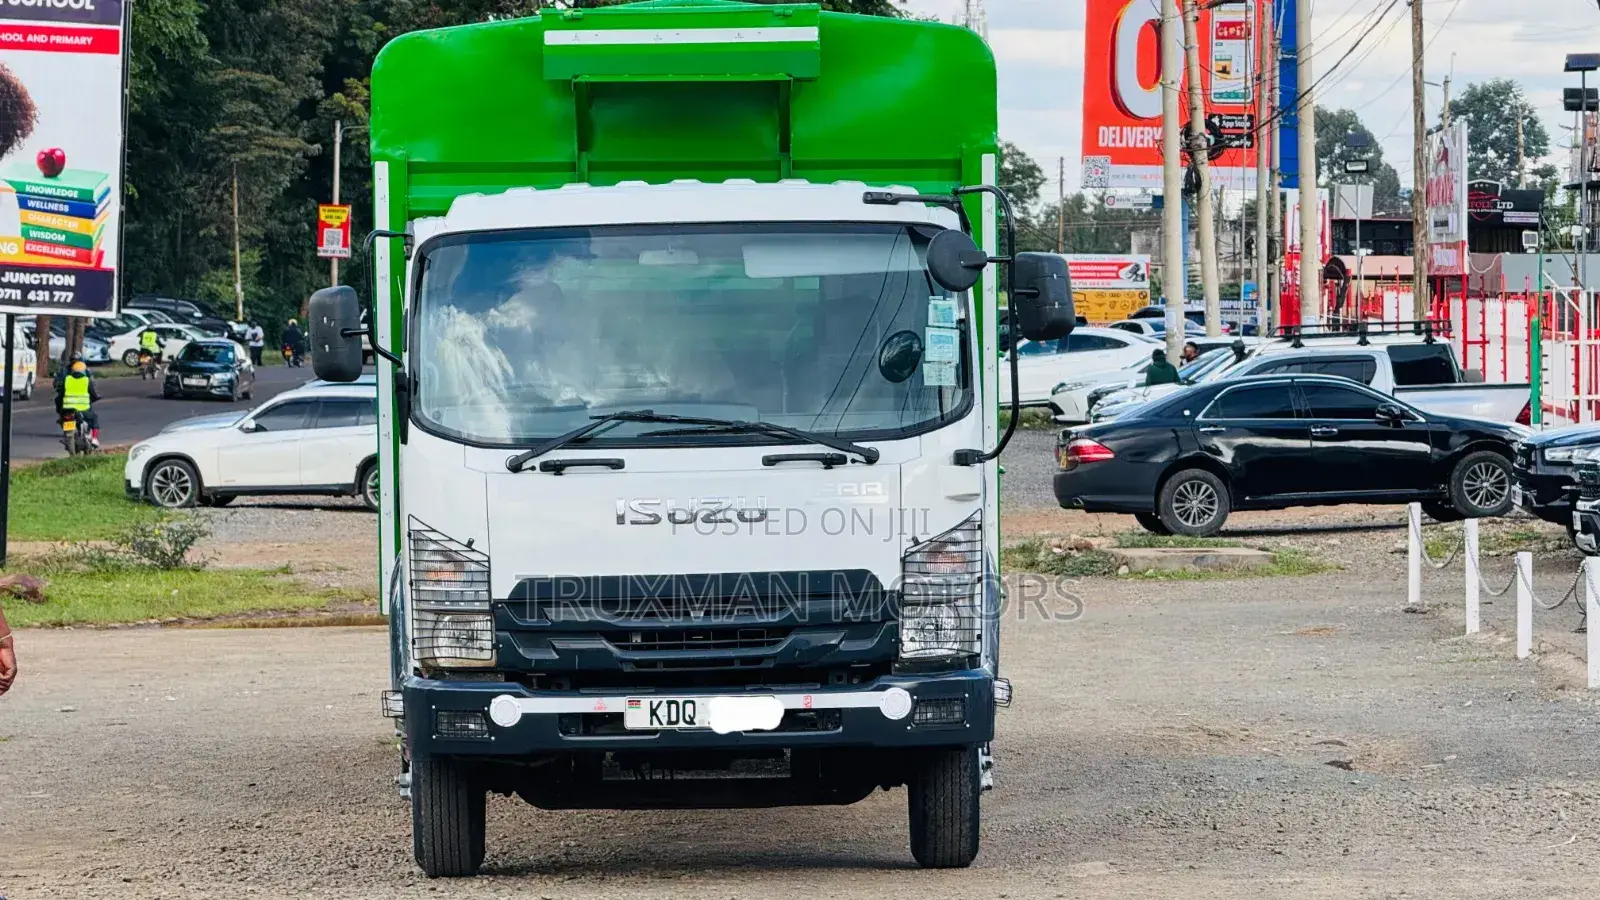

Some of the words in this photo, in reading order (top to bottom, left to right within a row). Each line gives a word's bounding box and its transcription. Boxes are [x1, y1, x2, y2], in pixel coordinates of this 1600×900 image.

[27, 34, 48, 43] AND
[49, 35, 93, 45] PRIMARY
[1221, 120, 1235, 128] App
[1098, 126, 1162, 148] DELIVERY
[25, 184, 78, 198] KNOWLEDGE
[27, 199, 69, 212] WELLNESS
[1496, 201, 1514, 209] LTD
[28, 214, 78, 229] CHARACTER
[29, 229, 65, 242] WISDOM
[25, 243, 77, 258] EXCELLENCE
[1, 272, 75, 286] JUNCTION
[27, 290, 49, 302] 431
[53, 291, 74, 303] 777
[615, 496, 767, 525] ISUZU
[649, 699, 697, 726] KDQ
